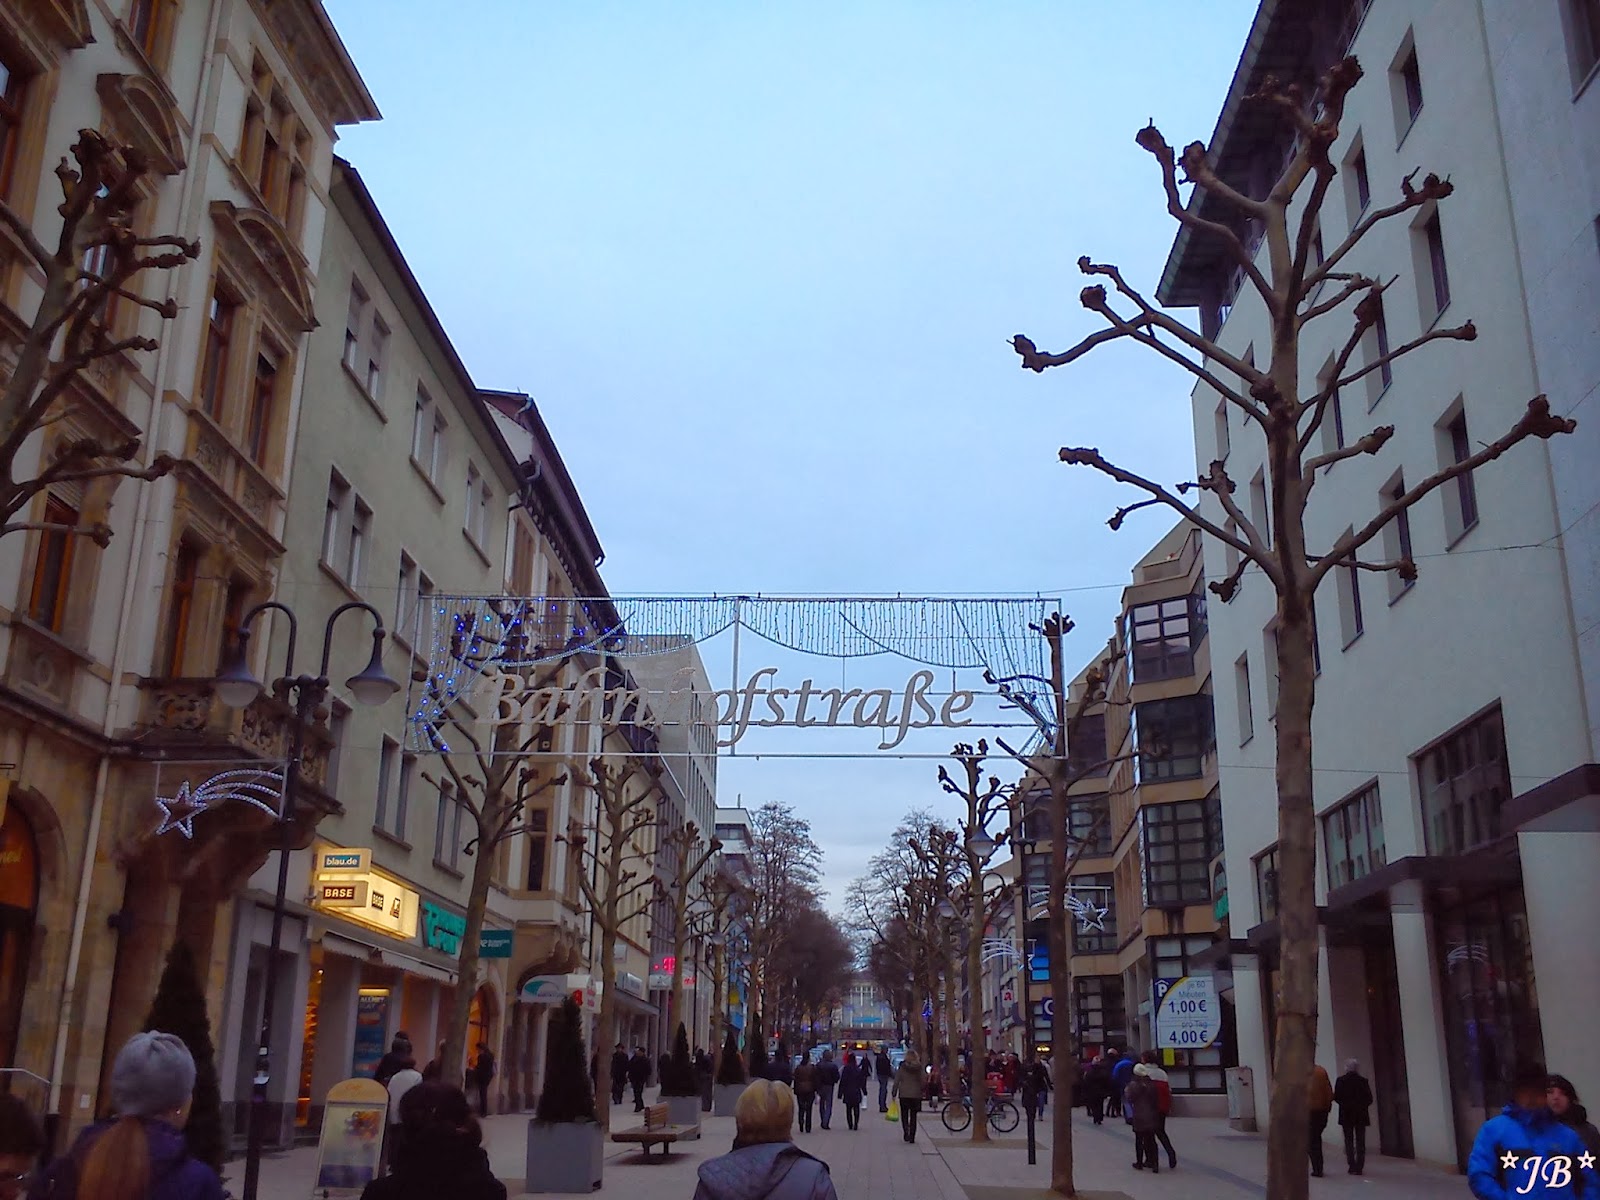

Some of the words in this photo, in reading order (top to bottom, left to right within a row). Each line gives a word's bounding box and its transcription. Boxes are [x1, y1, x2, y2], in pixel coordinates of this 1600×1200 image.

[477, 667, 974, 749] Bahnhofstraße
[325, 857, 358, 866] blau.de
[324, 887, 353, 899] BASE
[1196, 980, 1206, 988] 60
